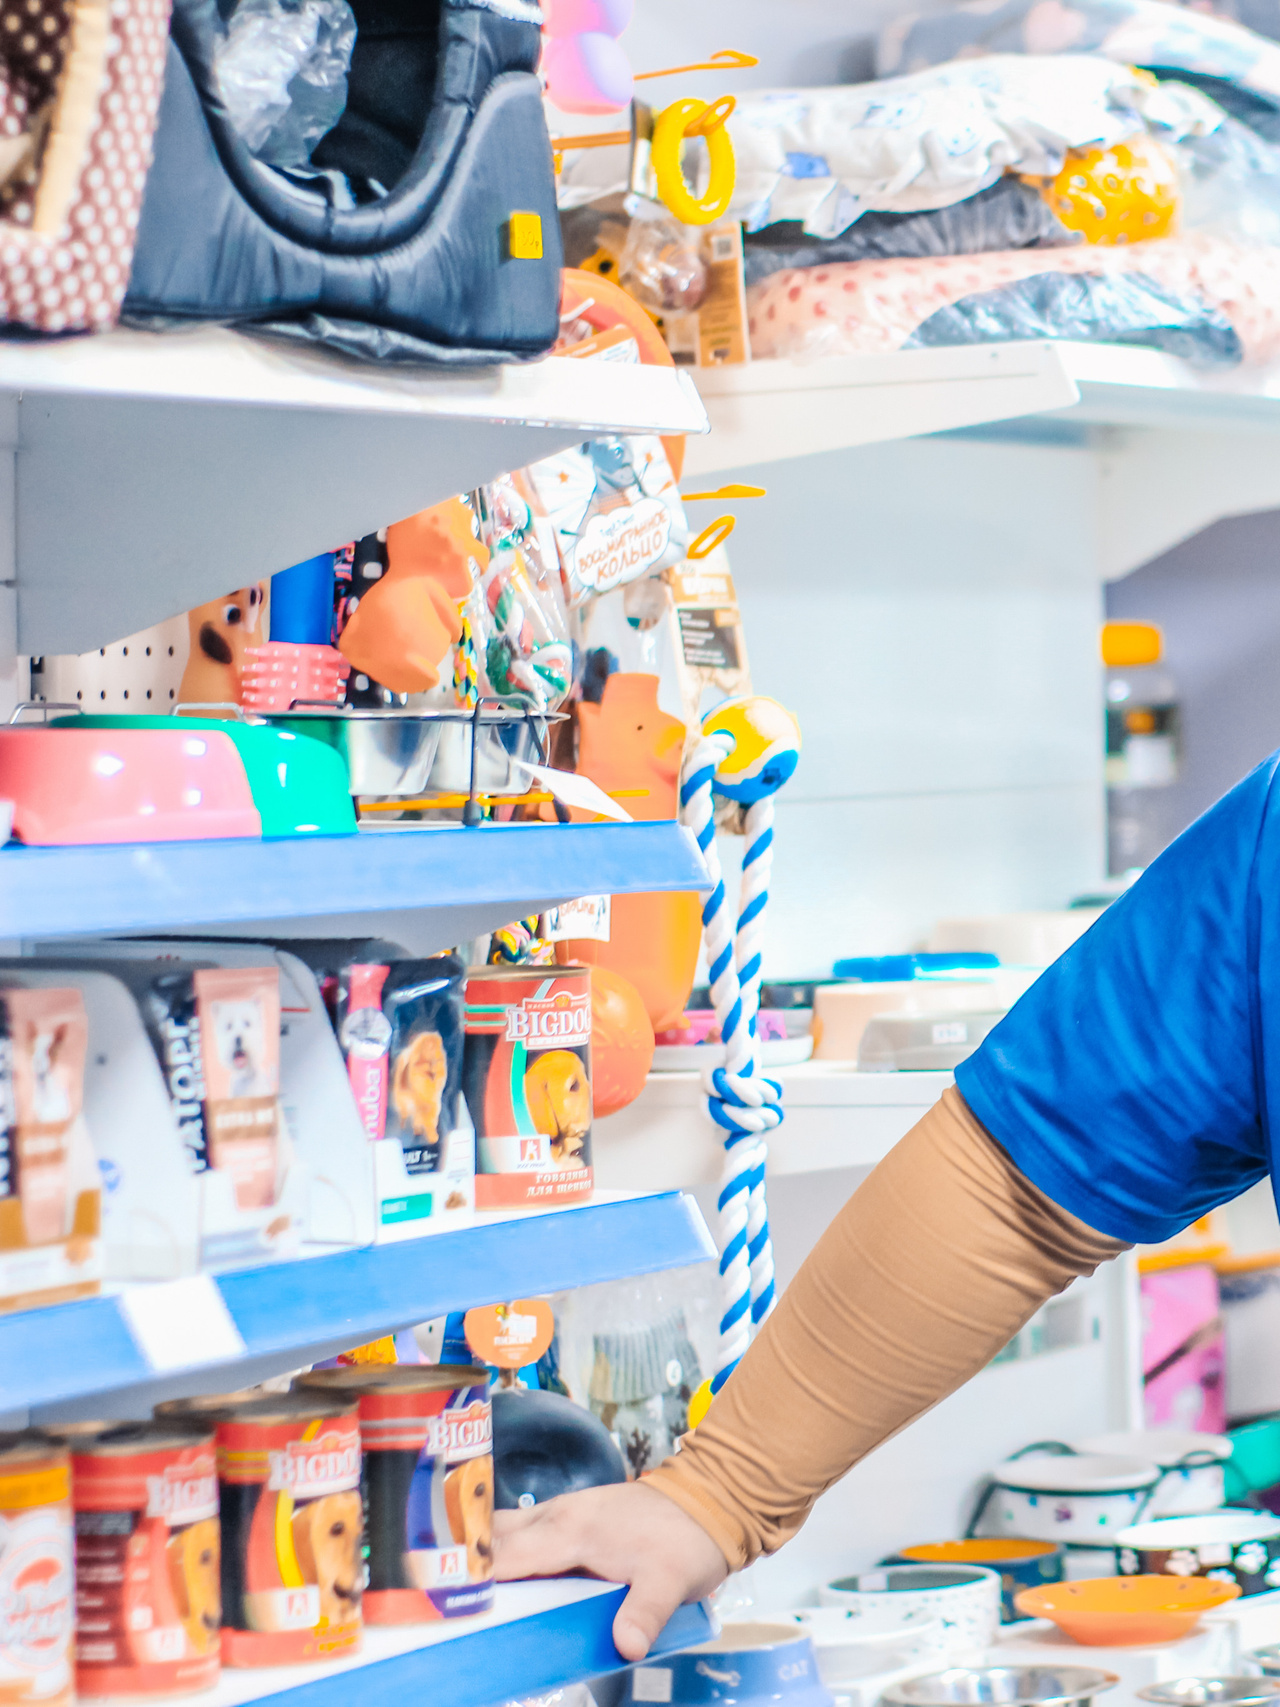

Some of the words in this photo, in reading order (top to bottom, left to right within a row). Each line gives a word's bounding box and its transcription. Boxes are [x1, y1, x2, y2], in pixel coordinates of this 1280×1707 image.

[596, 530, 663, 584] КОЛЬЦО
[527, 1185, 553, 1198] для
[777, 1659, 809, 1681] CAT
